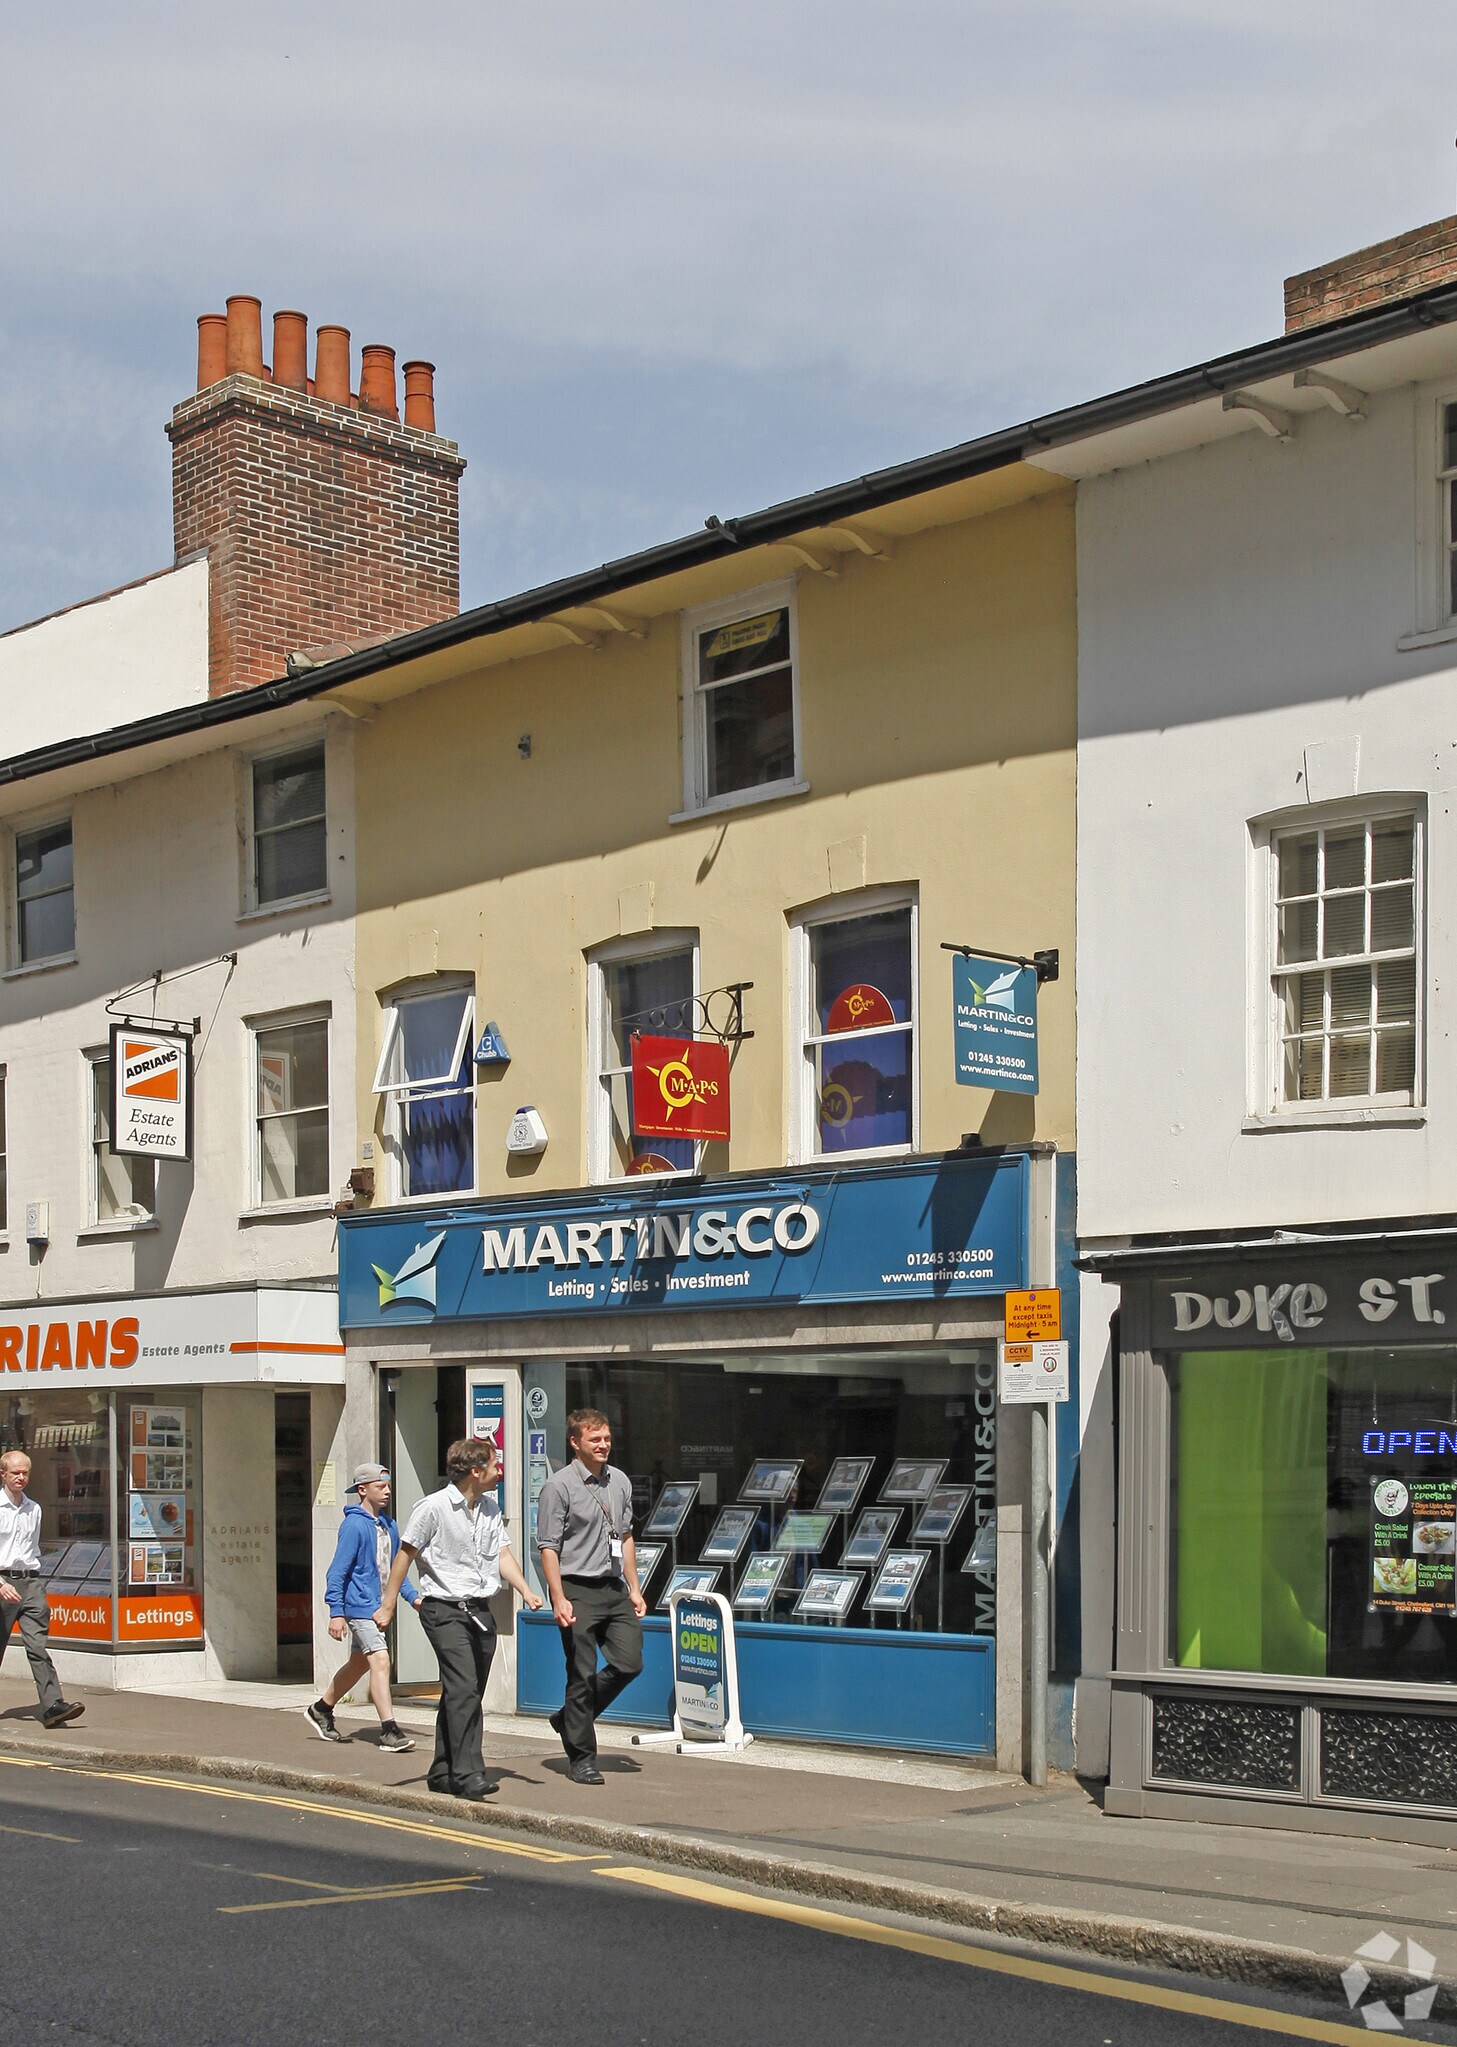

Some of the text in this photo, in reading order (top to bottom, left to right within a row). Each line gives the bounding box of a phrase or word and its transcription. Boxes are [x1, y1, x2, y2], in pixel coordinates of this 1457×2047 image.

[957, 1004, 1034, 1026] MARTIN&CO
[958, 1020, 1035, 1039] Letting Sales Investment
[477, 1050, 497, 1059] Chubb
[968, 1051, 1026, 1068] 01245 330500
[126, 1050, 178, 1079] ADRIANS
[960, 1063, 1035, 1082] www.martinco.com
[129, 1108, 174, 1127] Estate
[126, 1128, 177, 1146] Agents
[482, 1203, 821, 1271] MARTIN&CO
[906, 1248, 994, 1266] 01245 330500
[882, 1268, 994, 1283] www.martinco.com
[548, 1270, 750, 1300] Letting Sales Investment
[1008, 1320, 1037, 1329] Midnight
[142, 1346, 180, 1357] Estate
[184, 1342, 226, 1356] Agents
[1362, 1430, 1457, 1454] OPEN
[210, 1526, 270, 1535] ADRIANS
[220, 1540, 260, 1549] estate
[221, 1555, 261, 1566] agents
[126, 1606, 194, 1626] Lettings
[680, 1612, 718, 1632] Lettings
[680, 1630, 718, 1654] OPEN
[680, 1654, 718, 1668] 01245 330500
[681, 1696, 718, 1711] MARTIN&CO
